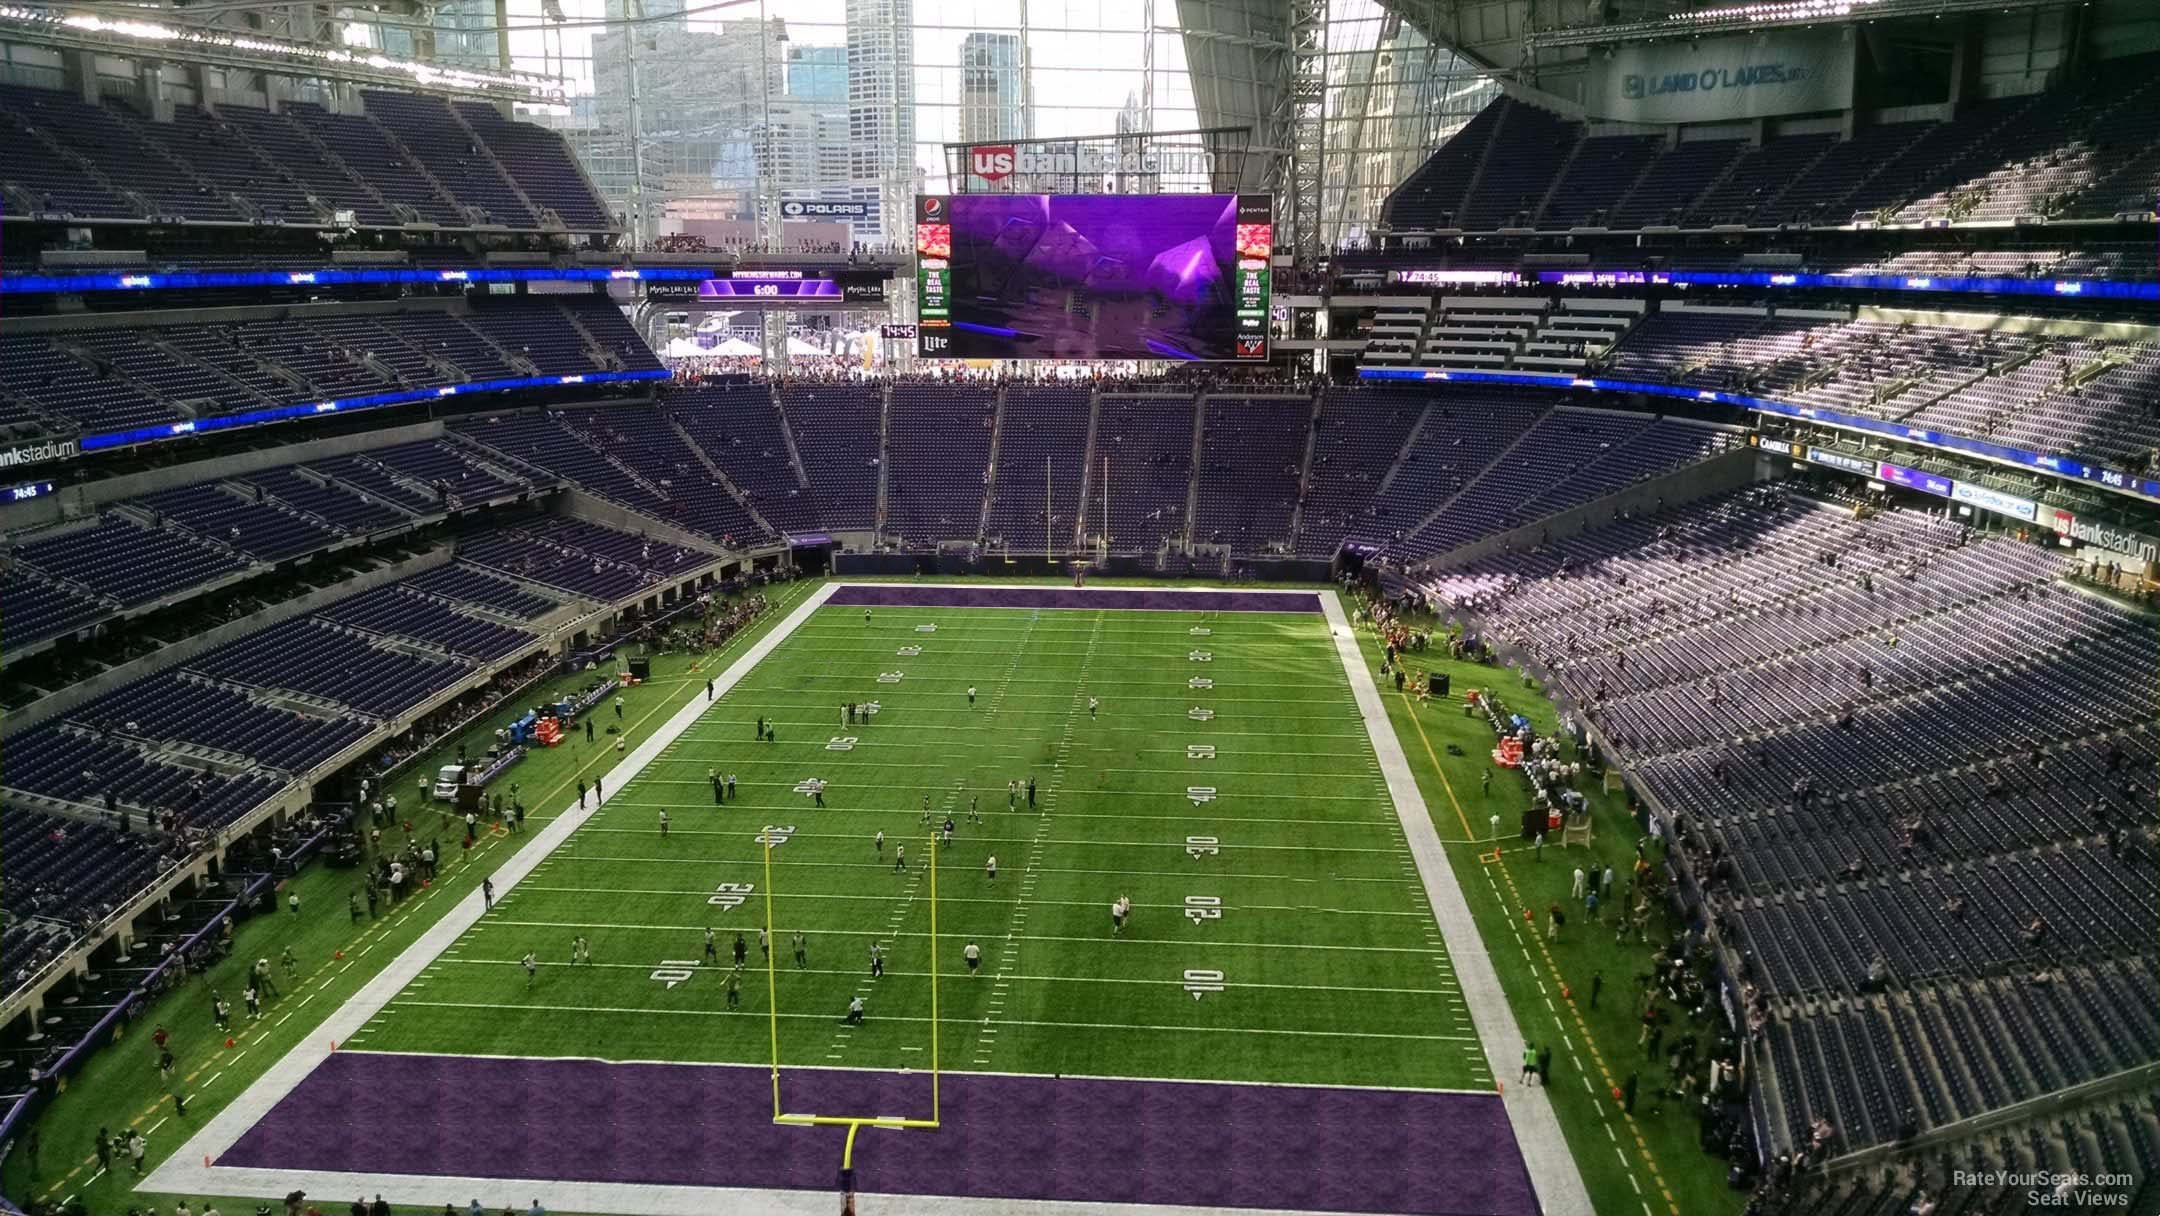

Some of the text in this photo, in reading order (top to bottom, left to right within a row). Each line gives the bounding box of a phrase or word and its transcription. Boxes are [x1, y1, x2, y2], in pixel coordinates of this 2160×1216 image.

[1649, 73, 1698, 96] LAND
[806, 204, 864, 214] POLARIS
[754, 285, 778, 295] 6:00
[1272, 309, 1287, 320] 40
[883, 326, 915, 337] 74:45
[924, 336, 948, 352] Lite
[13, 486, 37, 500] 74:45
[1187, 745, 1216, 759] 50
[754, 824, 796, 844] 30
[1185, 836, 1219, 855] 30
[707, 882, 755, 905] 20
[1184, 895, 1222, 919] 20
[650, 959, 701, 981] 10
[1183, 969, 1225, 992] 10
